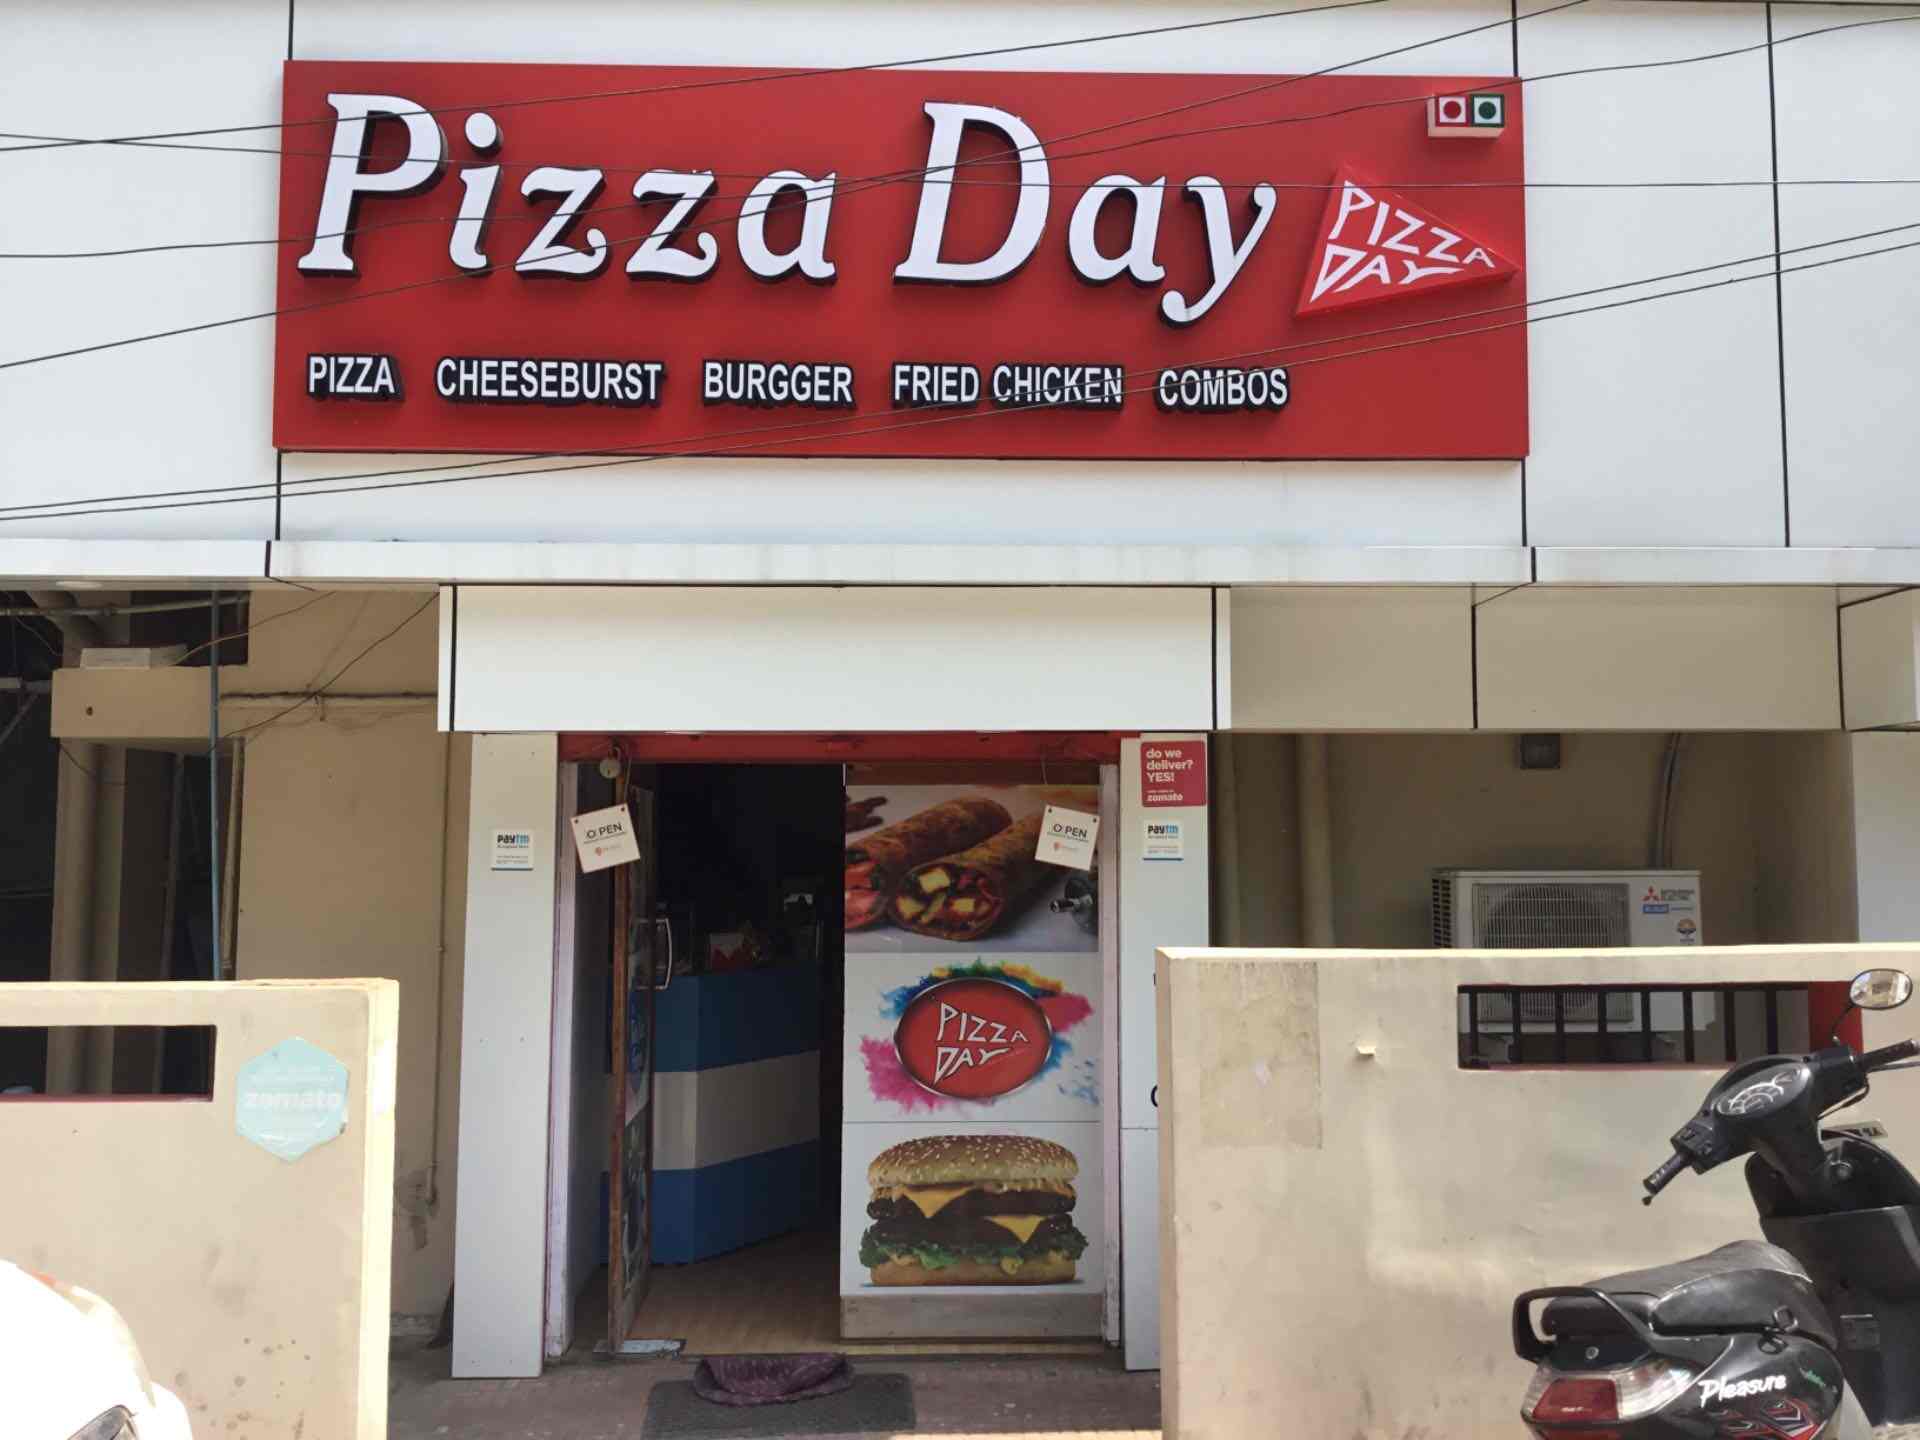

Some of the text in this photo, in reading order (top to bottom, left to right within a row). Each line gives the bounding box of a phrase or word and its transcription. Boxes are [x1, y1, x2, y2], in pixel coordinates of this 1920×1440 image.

[297, 92, 1278, 325] Pizza Day
[1328, 180, 1497, 268] PIZZA
[1309, 245, 1464, 303] DAY
[307, 355, 1289, 406] PIZZA CHEESEBURST BURGGER FRIED CHICKEN COMBOS
[1146, 748, 1182, 759] do we
[1146, 760, 1194, 770] deliver?
[1146, 771, 1175, 783] YES!
[1147, 793, 1184, 802] zomato
[936, 1001, 1028, 1043] PIZZA
[933, 1046, 1011, 1084] DAY
[1697, 1374, 1787, 1409] Pleasure
